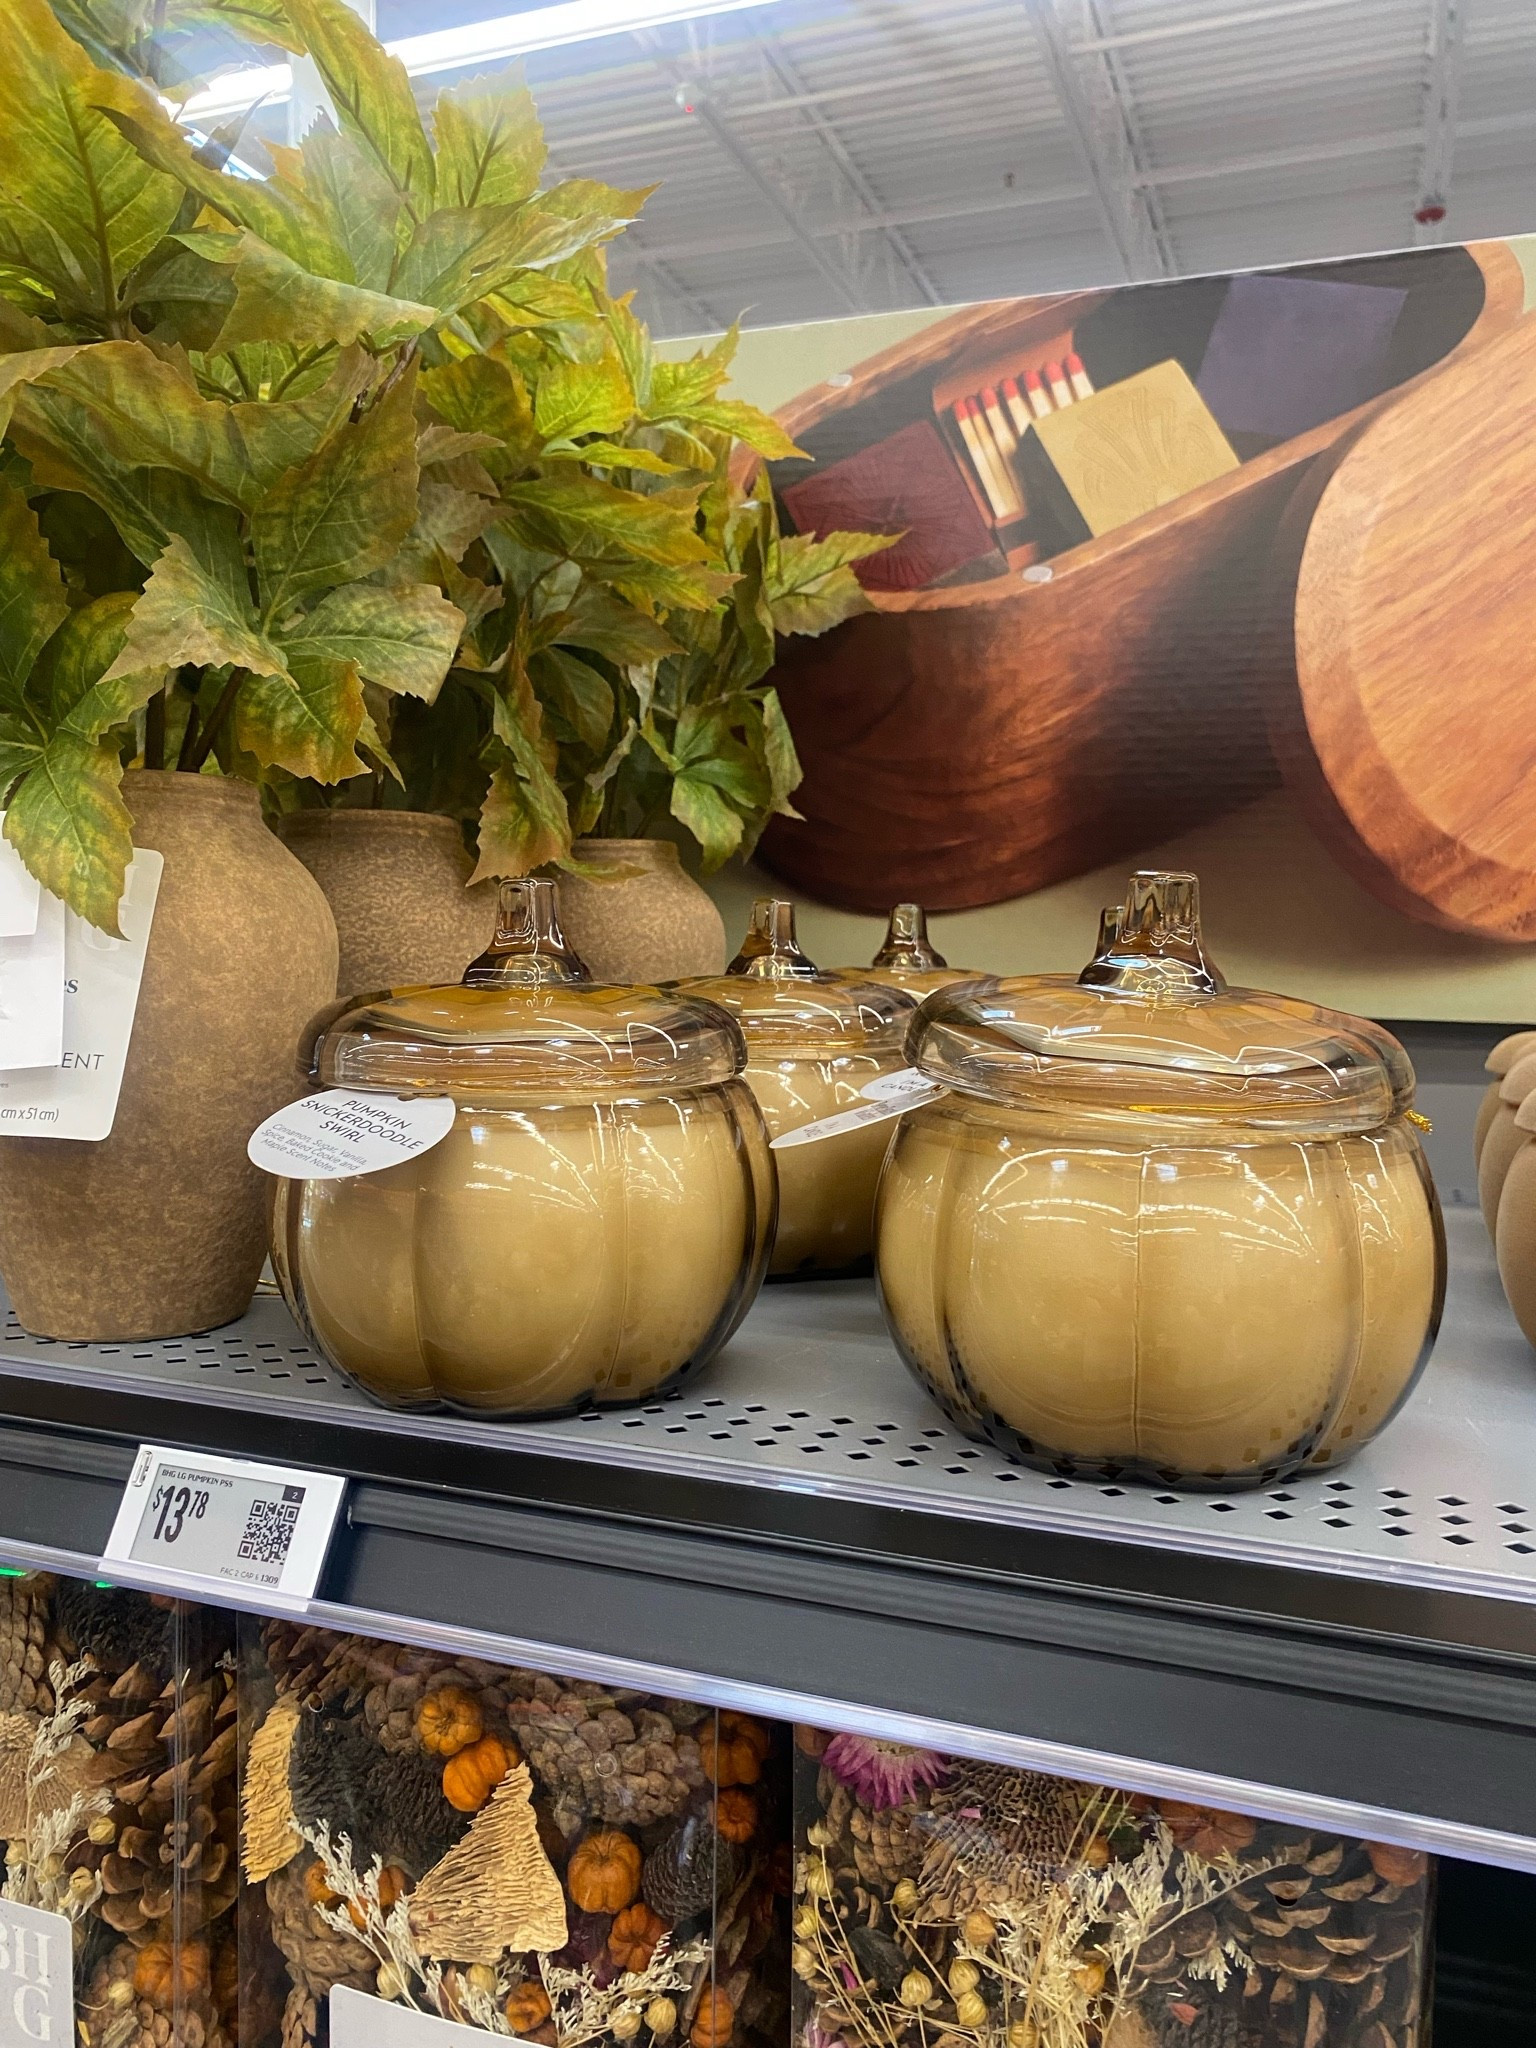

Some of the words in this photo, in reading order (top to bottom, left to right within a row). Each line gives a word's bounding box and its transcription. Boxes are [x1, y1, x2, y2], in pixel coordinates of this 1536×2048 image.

[54, 1052, 104, 1070] ENT
[301, 1100, 424, 1150] SNICKERDOODLE
[342, 1100, 413, 1130] PUMPKIN
[319, 1120, 366, 1144] SWIRL
[260, 1139, 287, 1152] Maple
[287, 1148, 312, 1161] Scent
[309, 1158, 337, 1172] Notes
[285, 1137, 312, 1152] Baked
[311, 1148, 341, 1164] Cookie
[340, 1160, 361, 1171] and
[162, 1469, 176, 1478] BHG
[177, 1472, 187, 1480] LG
[188, 1473, 219, 1485] PUMPKIN
[219, 1479, 234, 1487] PSS
[291, 1491, 299, 1500] 2
[220, 1567, 234, 1576] FAC
[241, 1570, 253, 1579] CAP
[260, 1574, 279, 1584] 1309
[13, 1985, 53, 2041] G
